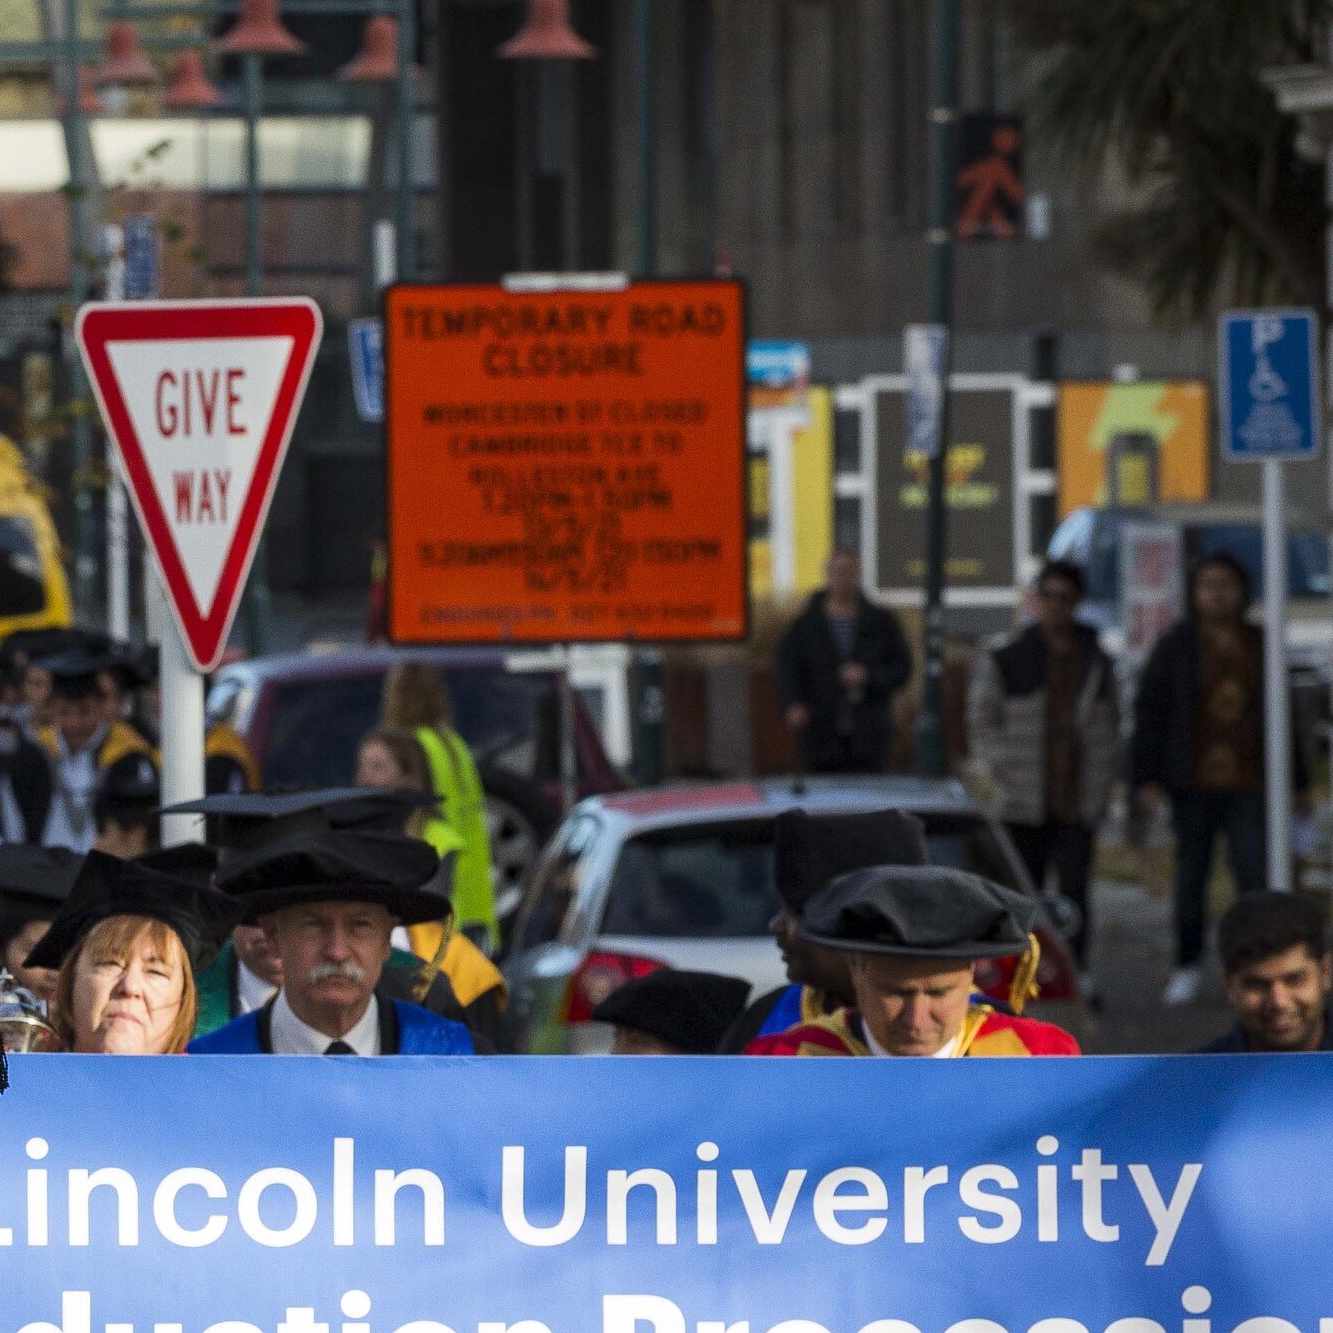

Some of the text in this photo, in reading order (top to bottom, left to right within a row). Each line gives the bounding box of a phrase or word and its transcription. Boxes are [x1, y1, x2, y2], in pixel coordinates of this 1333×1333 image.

[401, 303, 726, 340] TEMPORARY ROAD
[482, 343, 644, 378] CLOSURE
[155, 367, 248, 439] GIVE
[172, 468, 232, 525] WAY
[500, 1134, 1204, 1267] University
